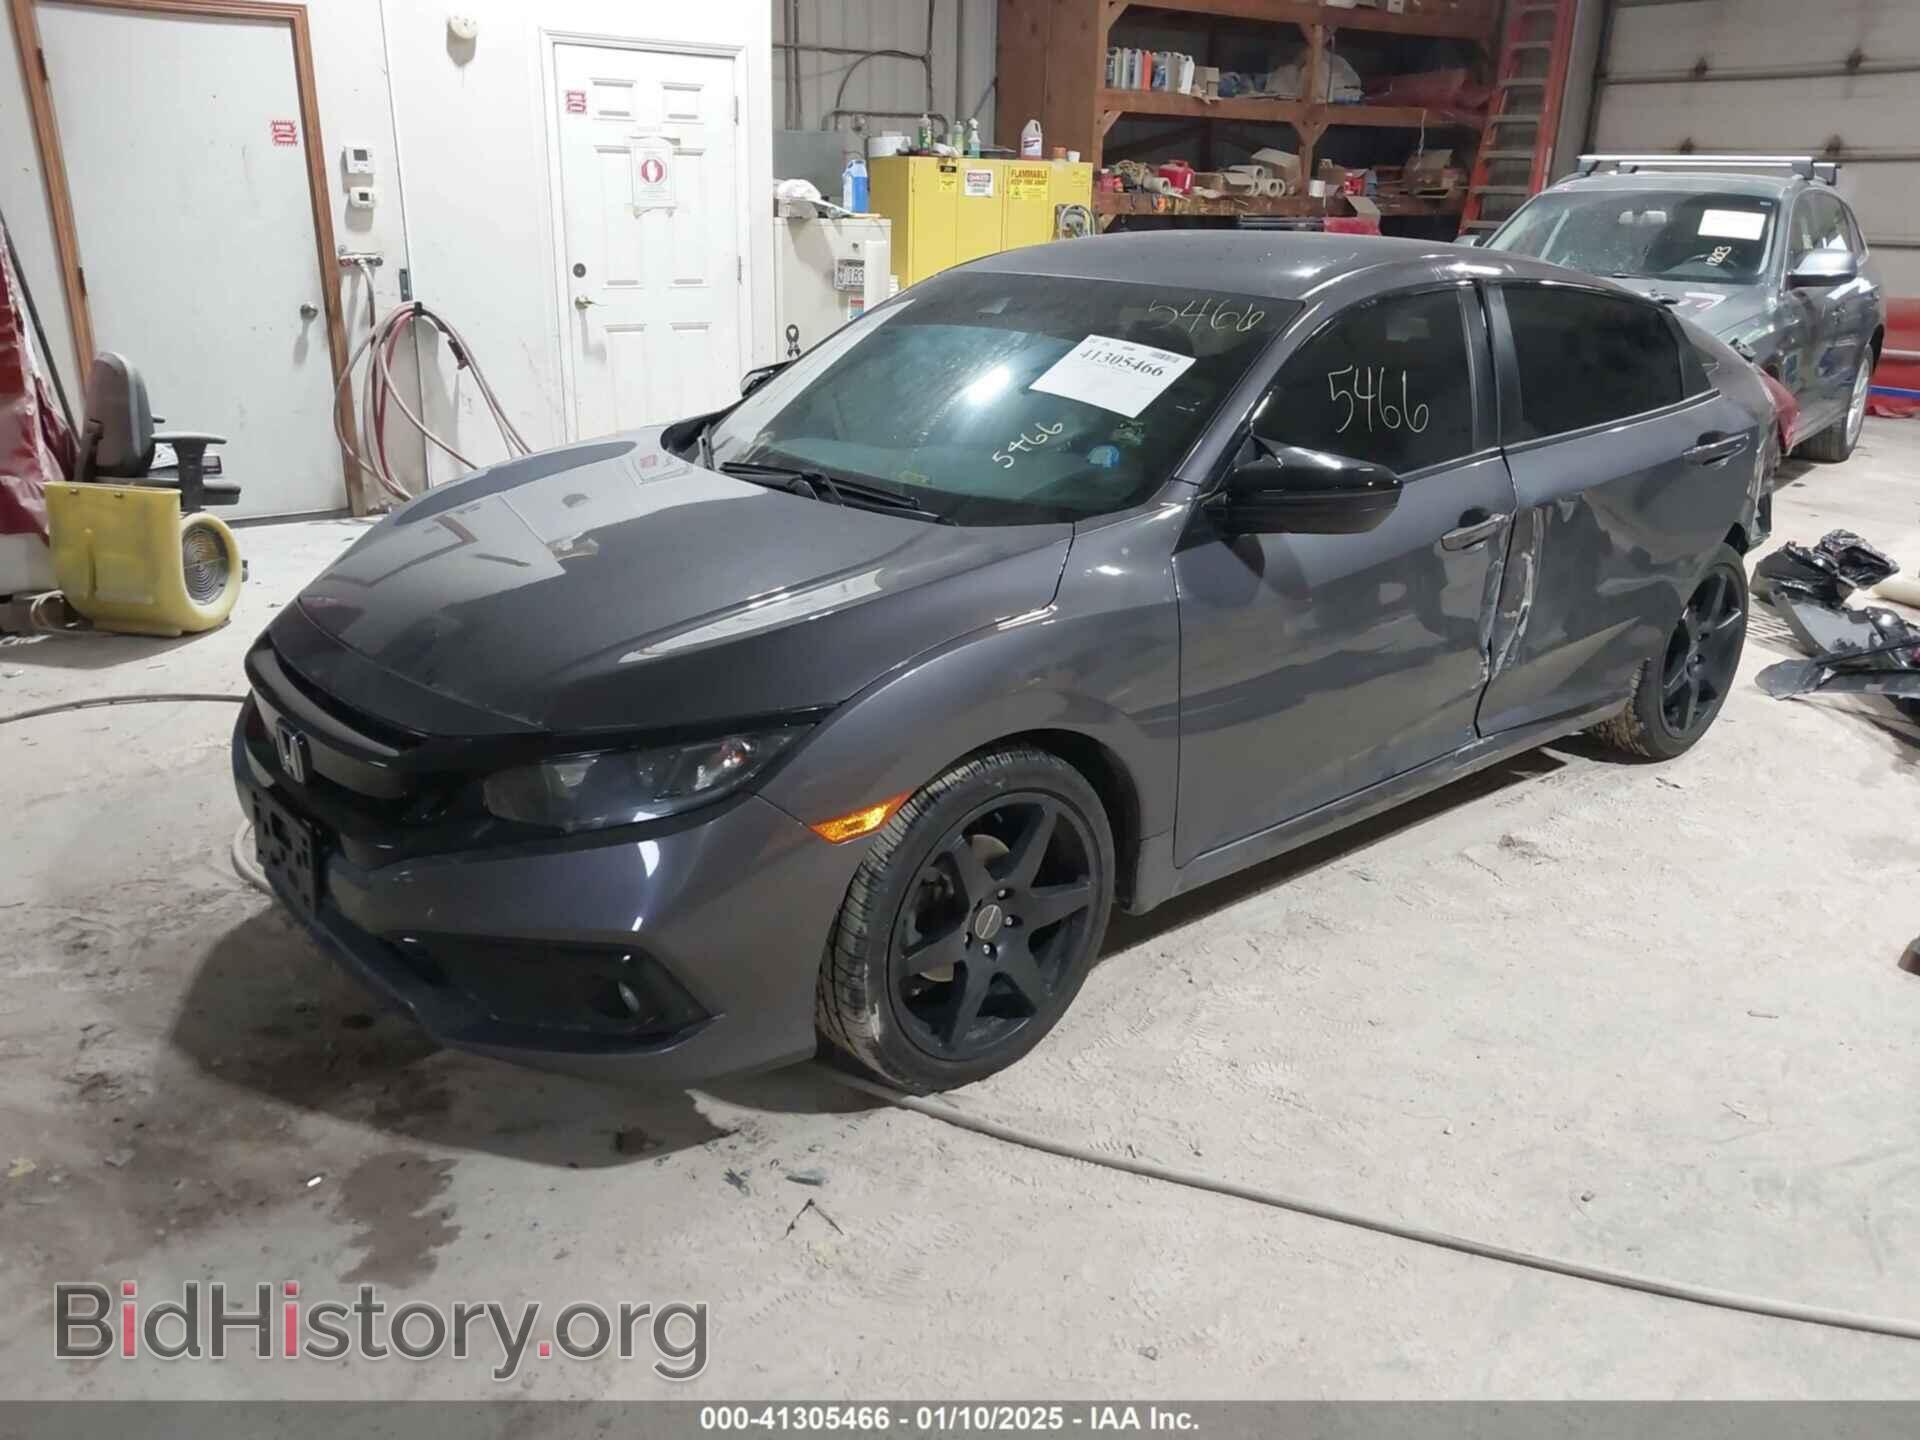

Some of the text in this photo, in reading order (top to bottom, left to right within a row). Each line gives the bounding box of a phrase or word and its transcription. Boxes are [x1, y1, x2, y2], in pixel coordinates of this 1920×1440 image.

[1148, 299, 1265, 334] 5466
[1079, 349, 1164, 377] 41305466
[1327, 364, 1429, 433] 5466
[992, 422, 1064, 469] 5466
